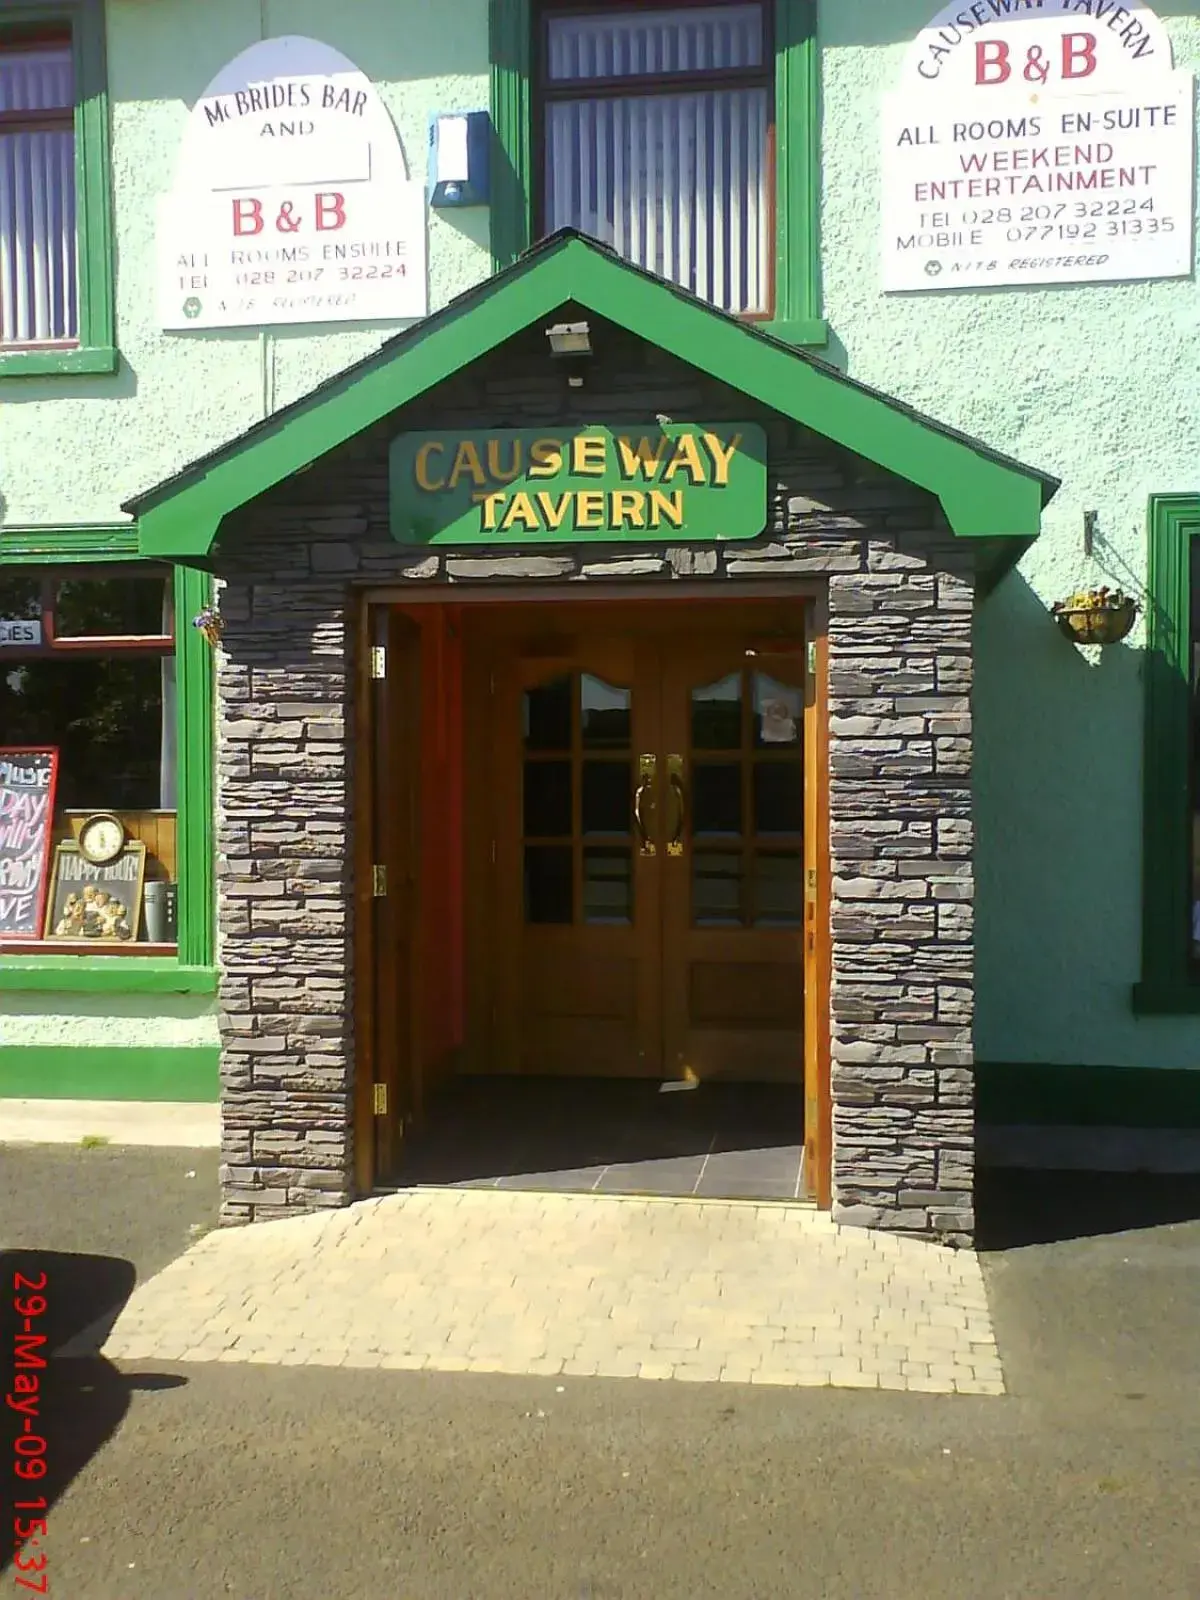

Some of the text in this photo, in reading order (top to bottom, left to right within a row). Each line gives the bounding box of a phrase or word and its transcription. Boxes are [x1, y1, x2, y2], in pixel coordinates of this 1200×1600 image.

[321, 84, 368, 117] BAR
[260, 120, 315, 137] AND
[896, 104, 1178, 147] ALL ROOMS EN-SUITE
[959, 143, 1114, 173] WEEKEND
[914, 165, 1158, 202] ENTERTAINMENT
[920, 197, 1156, 229] TEL 028 207 32224
[896, 216, 1176, 250] MOBILE 077192 31335
[231, 248, 310, 265] ROOMS
[338, 263, 406, 281] 32224
[1008, 254, 1110, 270] REGISTERED
[414, 432, 743, 493] CAUSEWAY
[472, 489, 687, 533] TAVERN
